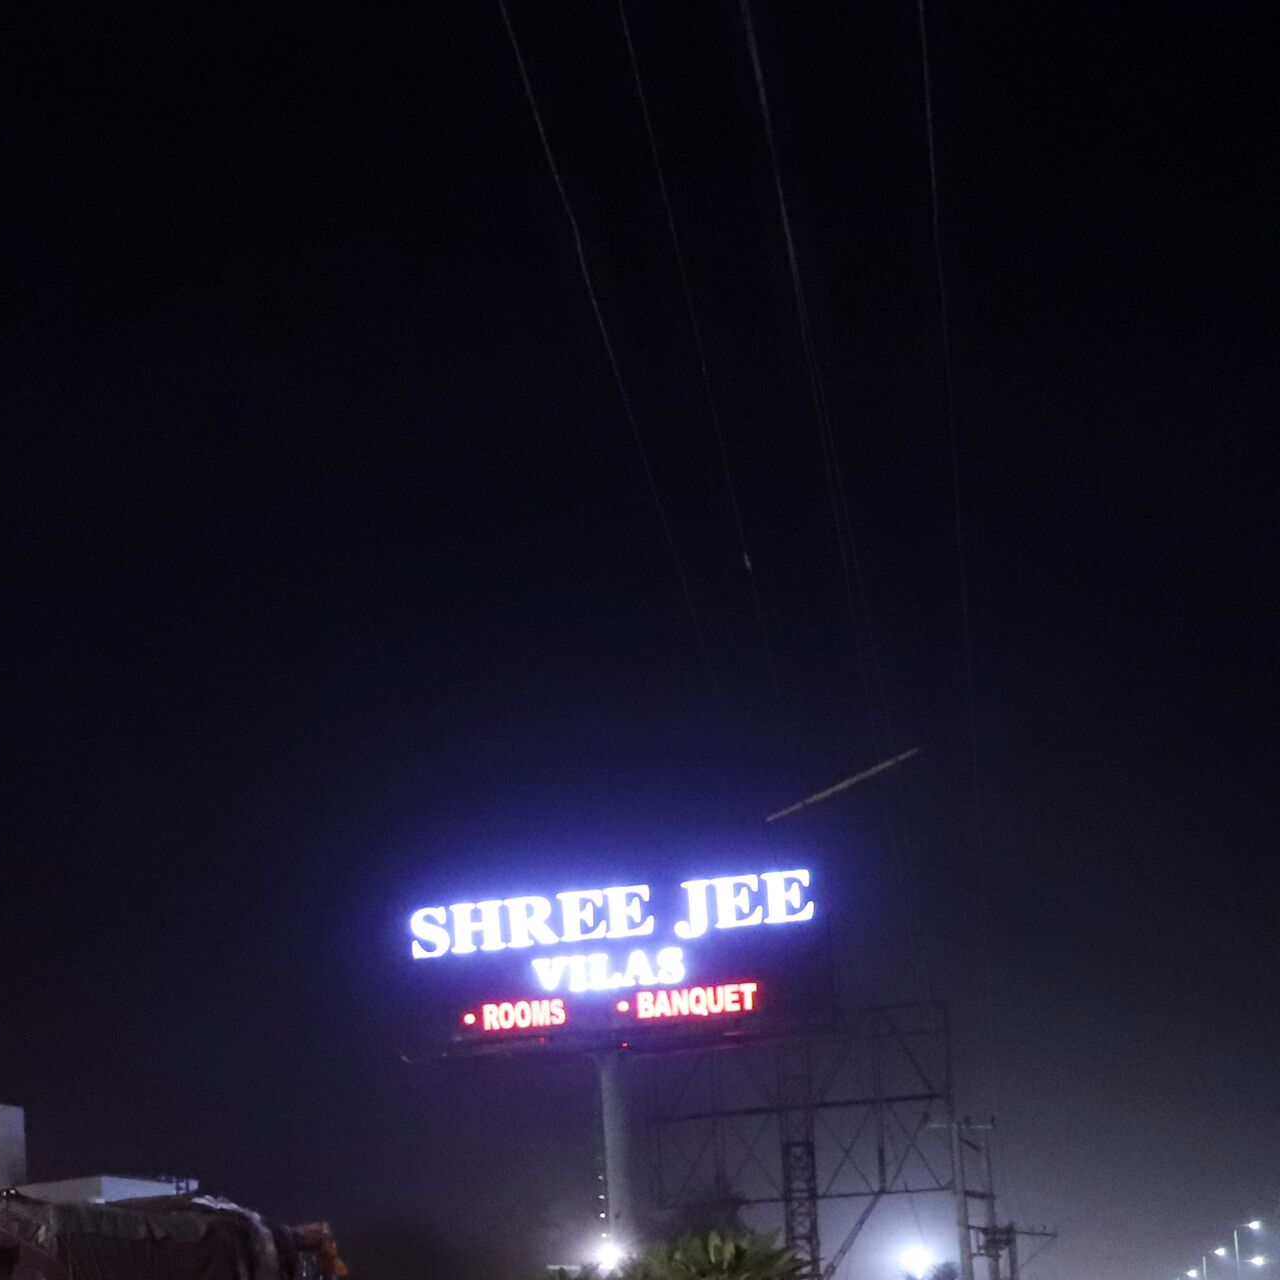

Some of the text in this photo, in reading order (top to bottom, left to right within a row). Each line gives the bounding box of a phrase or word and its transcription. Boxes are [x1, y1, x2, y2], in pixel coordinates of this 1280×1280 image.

[410, 869, 815, 960] SHREE JEE
[531, 946, 686, 992] VILAS
[482, 983, 758, 1031] ROOMS BANQUET
